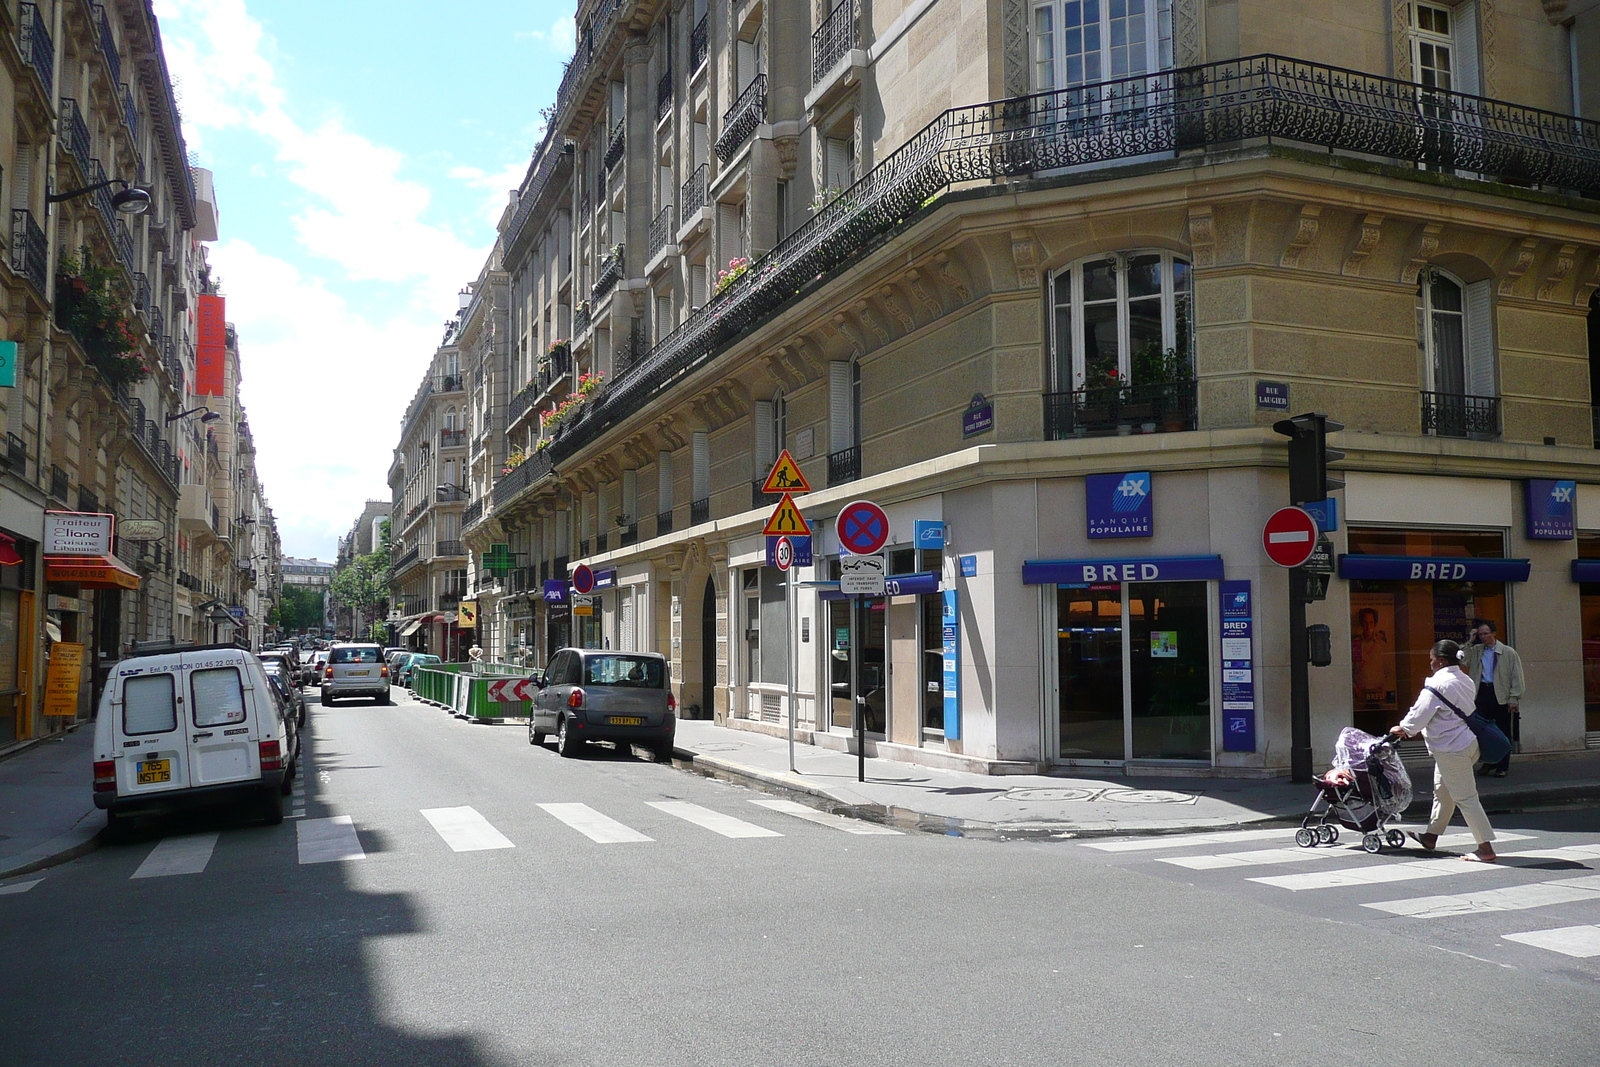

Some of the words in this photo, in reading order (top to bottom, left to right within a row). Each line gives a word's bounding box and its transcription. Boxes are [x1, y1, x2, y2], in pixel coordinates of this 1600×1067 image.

[202, 301, 213, 366] WALDORF
[1258, 396, 1287, 405] LAUGIER
[973, 412, 981, 420] RUE
[55, 518, 102, 527] Traiteur
[1090, 516, 1148, 526] BANQUE
[1090, 525, 1149, 534] POPULAIRE
[779, 547, 789, 560] 30
[1082, 565, 1159, 582] BRED
[1410, 562, 1466, 580] BRED
[544, 590, 562, 600] AXA
[1223, 622, 1248, 630] BRED
[170, 663, 193, 671] SIMON
[145, 761, 162, 771] 765
[139, 772, 157, 783] NST
[158, 770, 170, 780] 75
